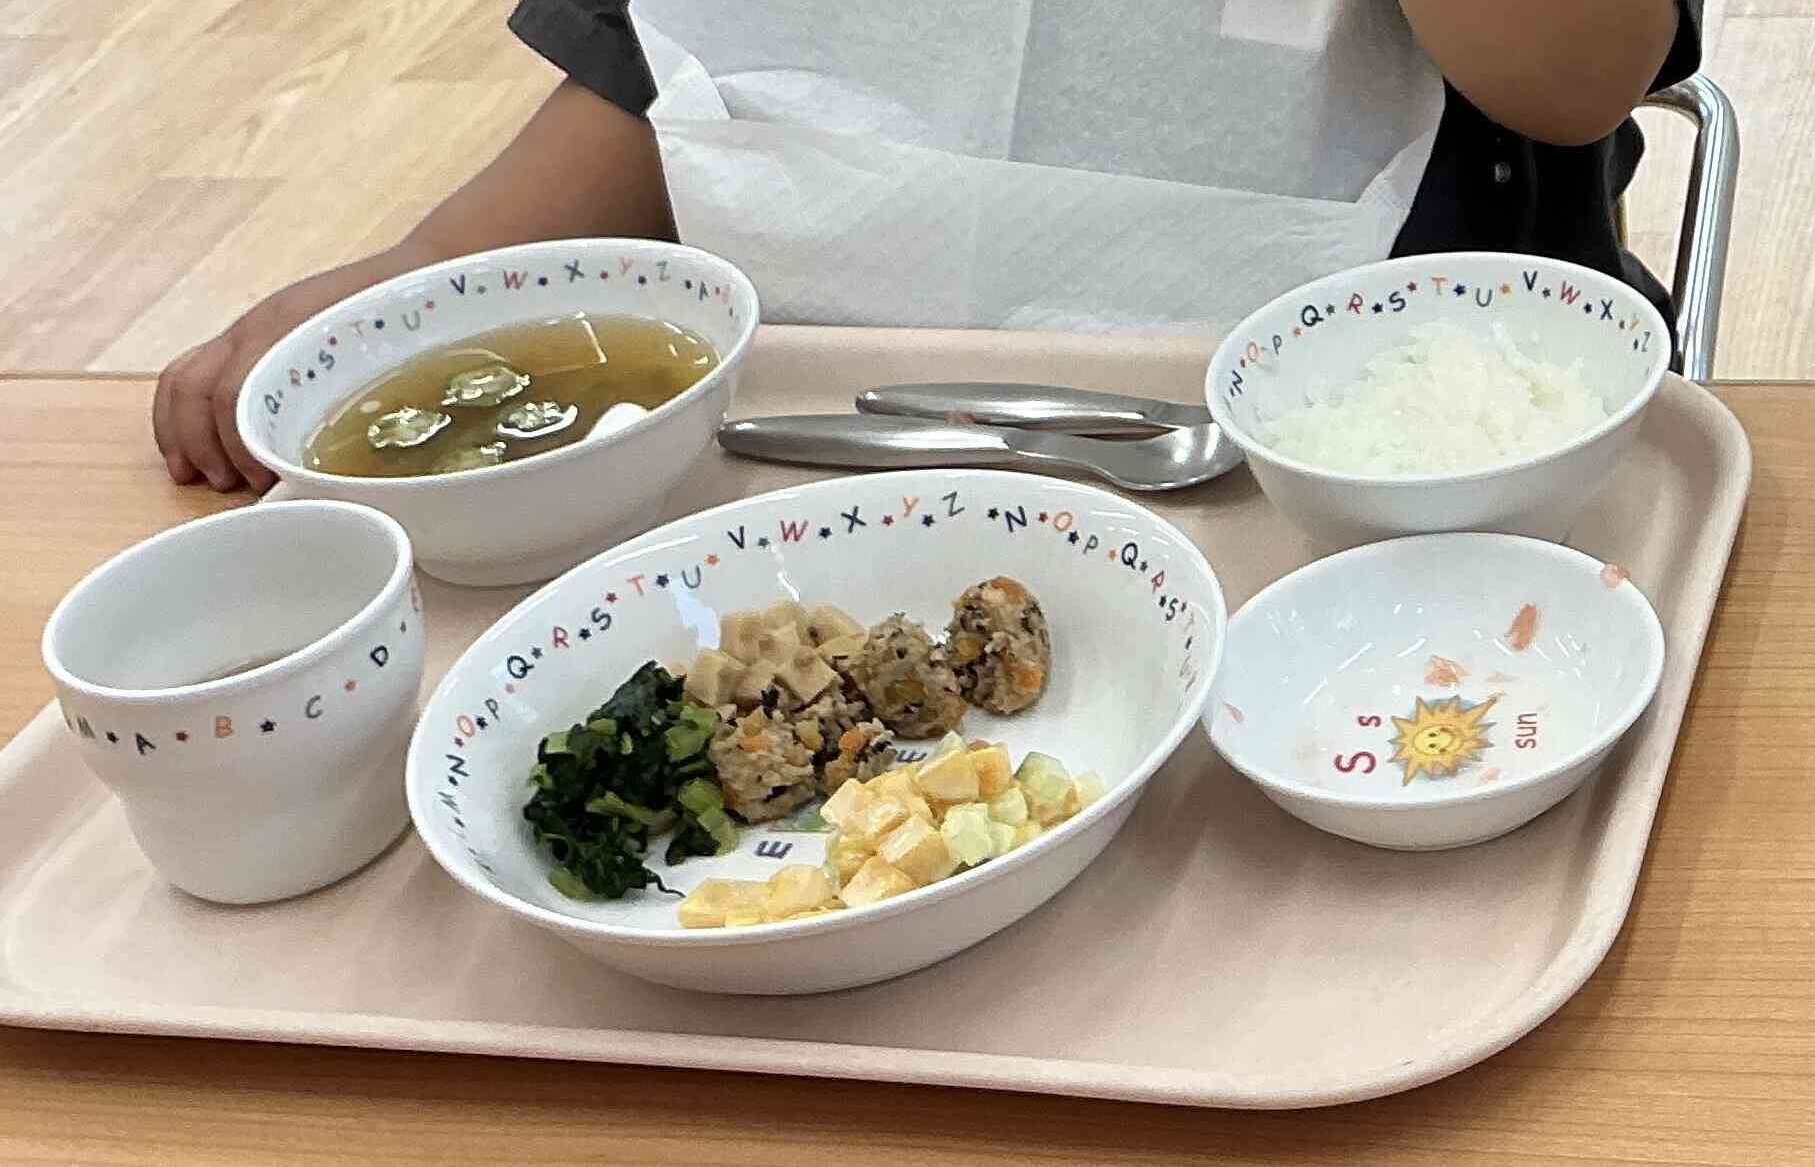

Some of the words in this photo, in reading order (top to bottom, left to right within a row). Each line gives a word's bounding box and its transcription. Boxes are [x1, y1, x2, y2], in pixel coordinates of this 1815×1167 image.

[319, 349, 335, 370] S
[403, 311, 420, 331] U
[450, 273, 466, 295] V
[503, 270, 527, 291] W
[566, 258, 584, 282] X
[1232, 369, 1243, 394] N
[1273, 334, 1282, 355] P
[1301, 304, 1323, 325] Q
[1346, 292, 1364, 313] R
[1389, 291, 1406, 312] S
[1431, 276, 1448, 296] T
[1475, 287, 1493, 307] U
[1523, 270, 1537, 291] V
[1560, 280, 1581, 304] W
[1600, 298, 1613, 320] X
[445, 753, 469, 777] N
[457, 713, 475, 738] O
[485, 697, 499, 720] P
[507, 654, 535, 679] Q
[553, 626, 569, 649] R
[591, 606, 612, 630] S
[627, 574, 645, 596] T
[682, 566, 701, 589] U
[727, 525, 745, 549] V
[781, 519, 808, 542] W
[841, 505, 866, 533] X
[904, 496, 919, 517] Y
[943, 491, 966, 517] Z
[1005, 505, 1028, 532] N
[1054, 511, 1073, 532] O
[1084, 533, 1098, 553] P
[1121, 541, 1140, 570] Q
[1166, 597, 1178, 621] S
[135, 731, 156, 755] A
[214, 715, 234, 738] B
[306, 694, 322, 718] C
[371, 644, 389, 667] D
[1335, 751, 1376, 775] S
[1358, 713, 1381, 728] s
[1515, 711, 1538, 749] sun
